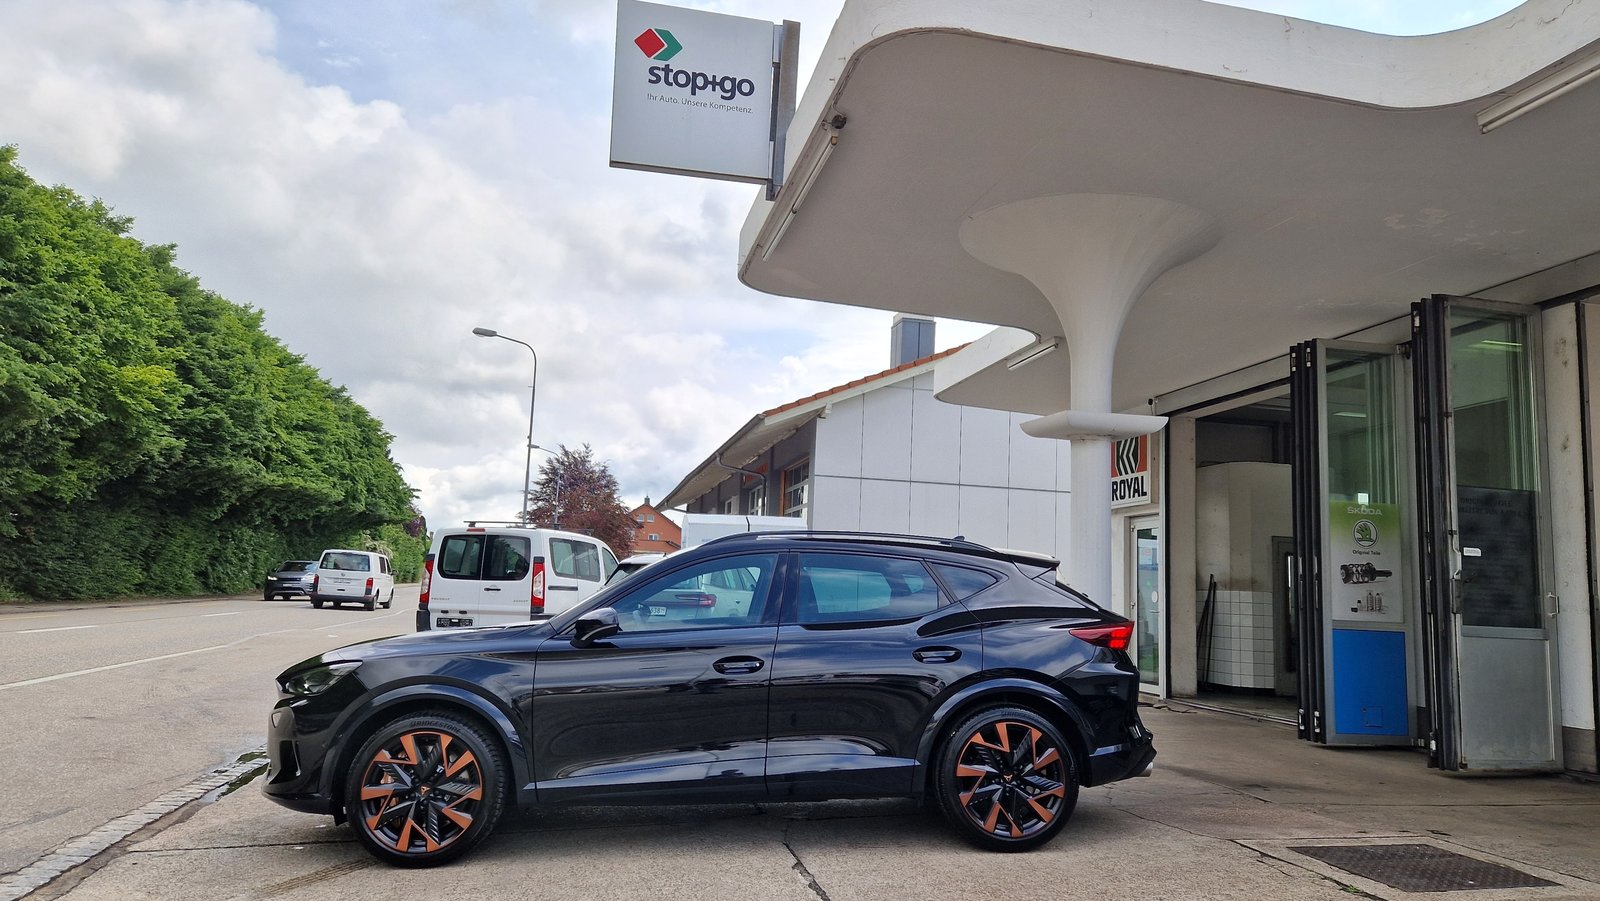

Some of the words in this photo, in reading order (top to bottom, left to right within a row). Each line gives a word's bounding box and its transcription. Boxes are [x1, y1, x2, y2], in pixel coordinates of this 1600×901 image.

[648, 64, 755, 101] stop+go
[647, 93, 658, 101] Ihr
[660, 95, 680, 104] Auto.
[681, 98, 708, 108] Unsere
[709, 102, 754, 114] Kompetenz.
[1111, 475, 1148, 502] ROYAL
